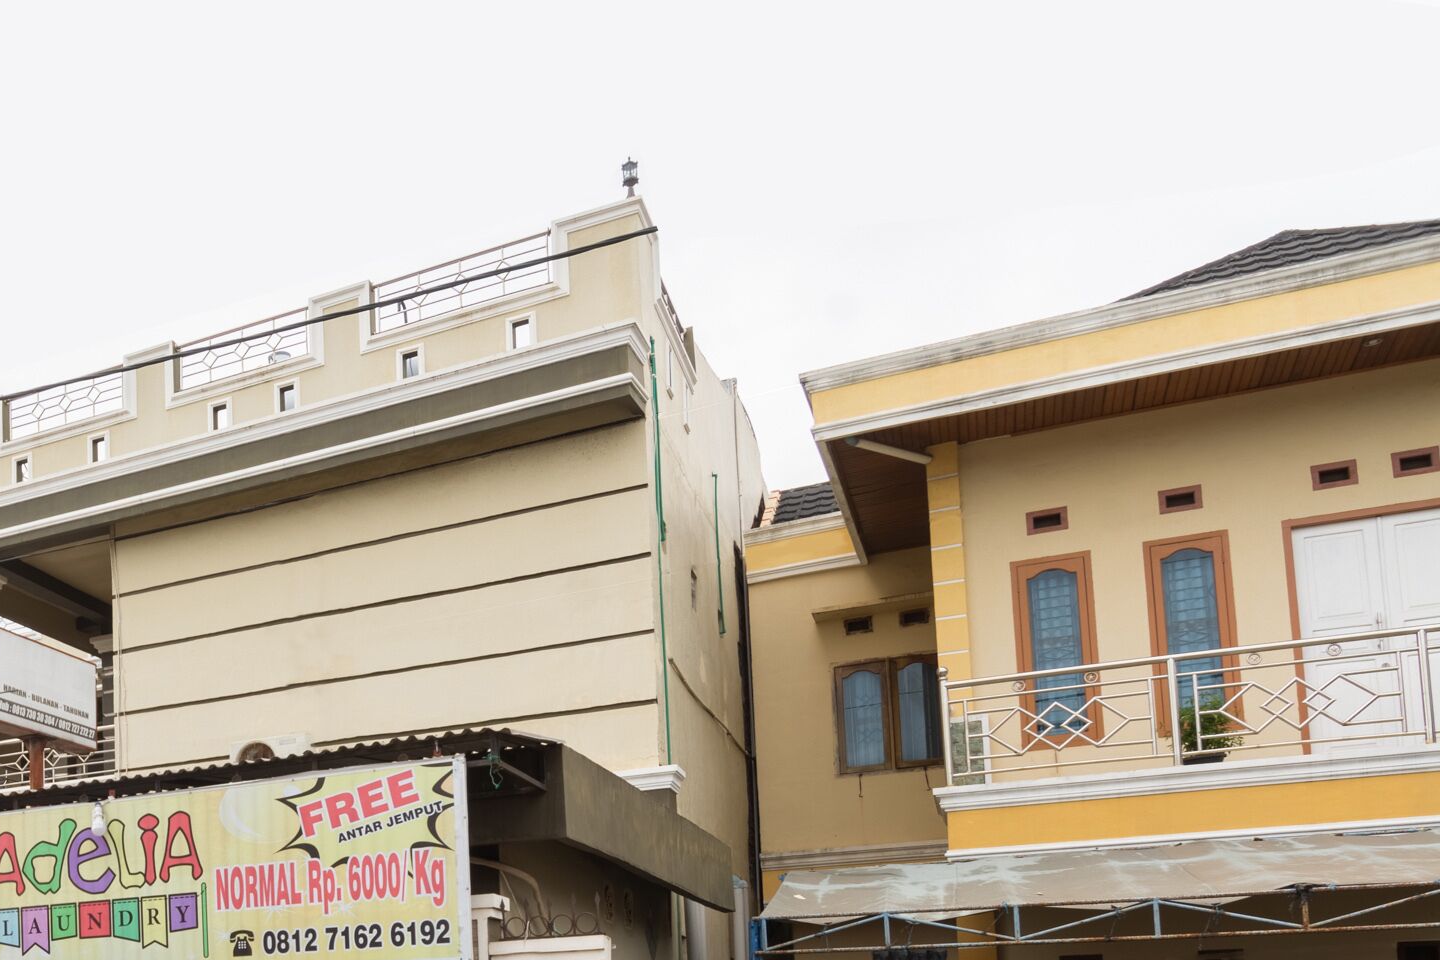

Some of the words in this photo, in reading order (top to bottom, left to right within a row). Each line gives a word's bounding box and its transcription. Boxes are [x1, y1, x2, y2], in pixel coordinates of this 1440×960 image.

[32, 694, 59, 709] BULANAN
[64, 705, 89, 719] TAHUNAN
[298, 769, 420, 838] FREE
[338, 821, 383, 844] ANTAR
[386, 800, 443, 828] JEMPUT
[215, 862, 302, 911] NORMAL
[308, 860, 342, 914] Rp.
[1, 902, 191, 941] LAUNDRY
[263, 928, 318, 954] 0812
[325, 924, 382, 950] 7162
[390, 918, 451, 947] 6192
